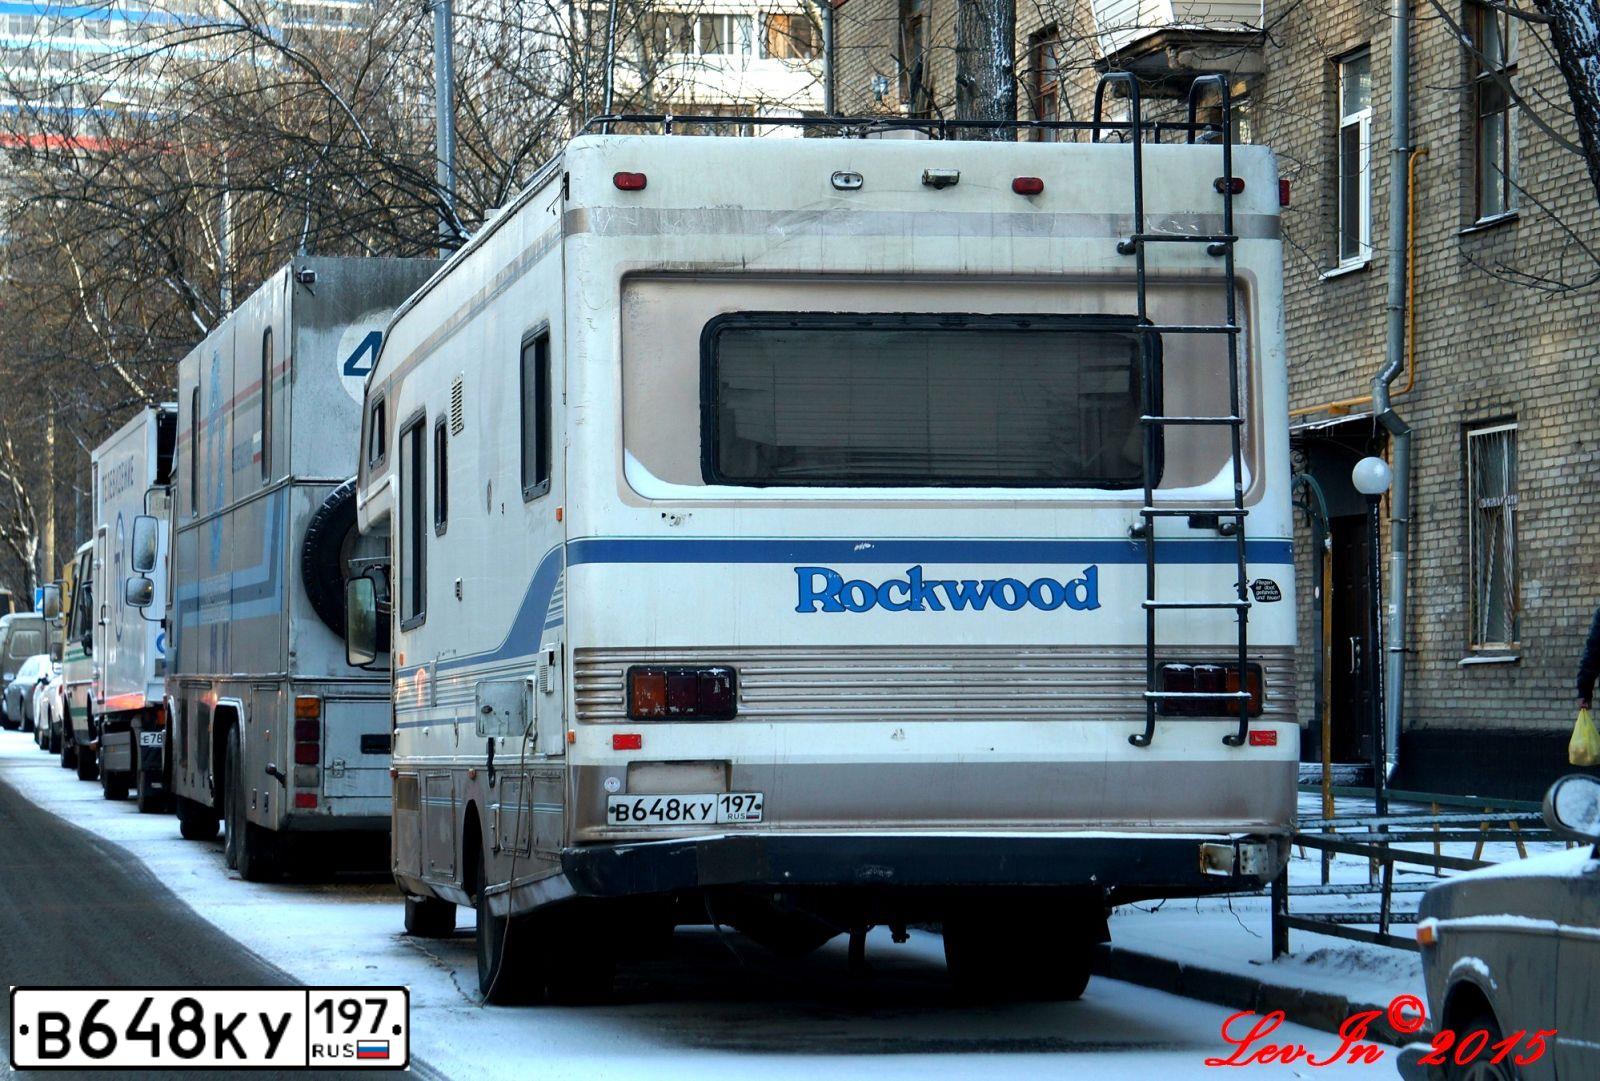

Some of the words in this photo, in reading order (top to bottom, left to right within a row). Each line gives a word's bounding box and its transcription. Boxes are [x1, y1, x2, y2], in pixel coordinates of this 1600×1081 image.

[794, 564, 1101, 613] Rockwood
[721, 795, 757, 813] 197
[728, 812, 746, 820] RUS
